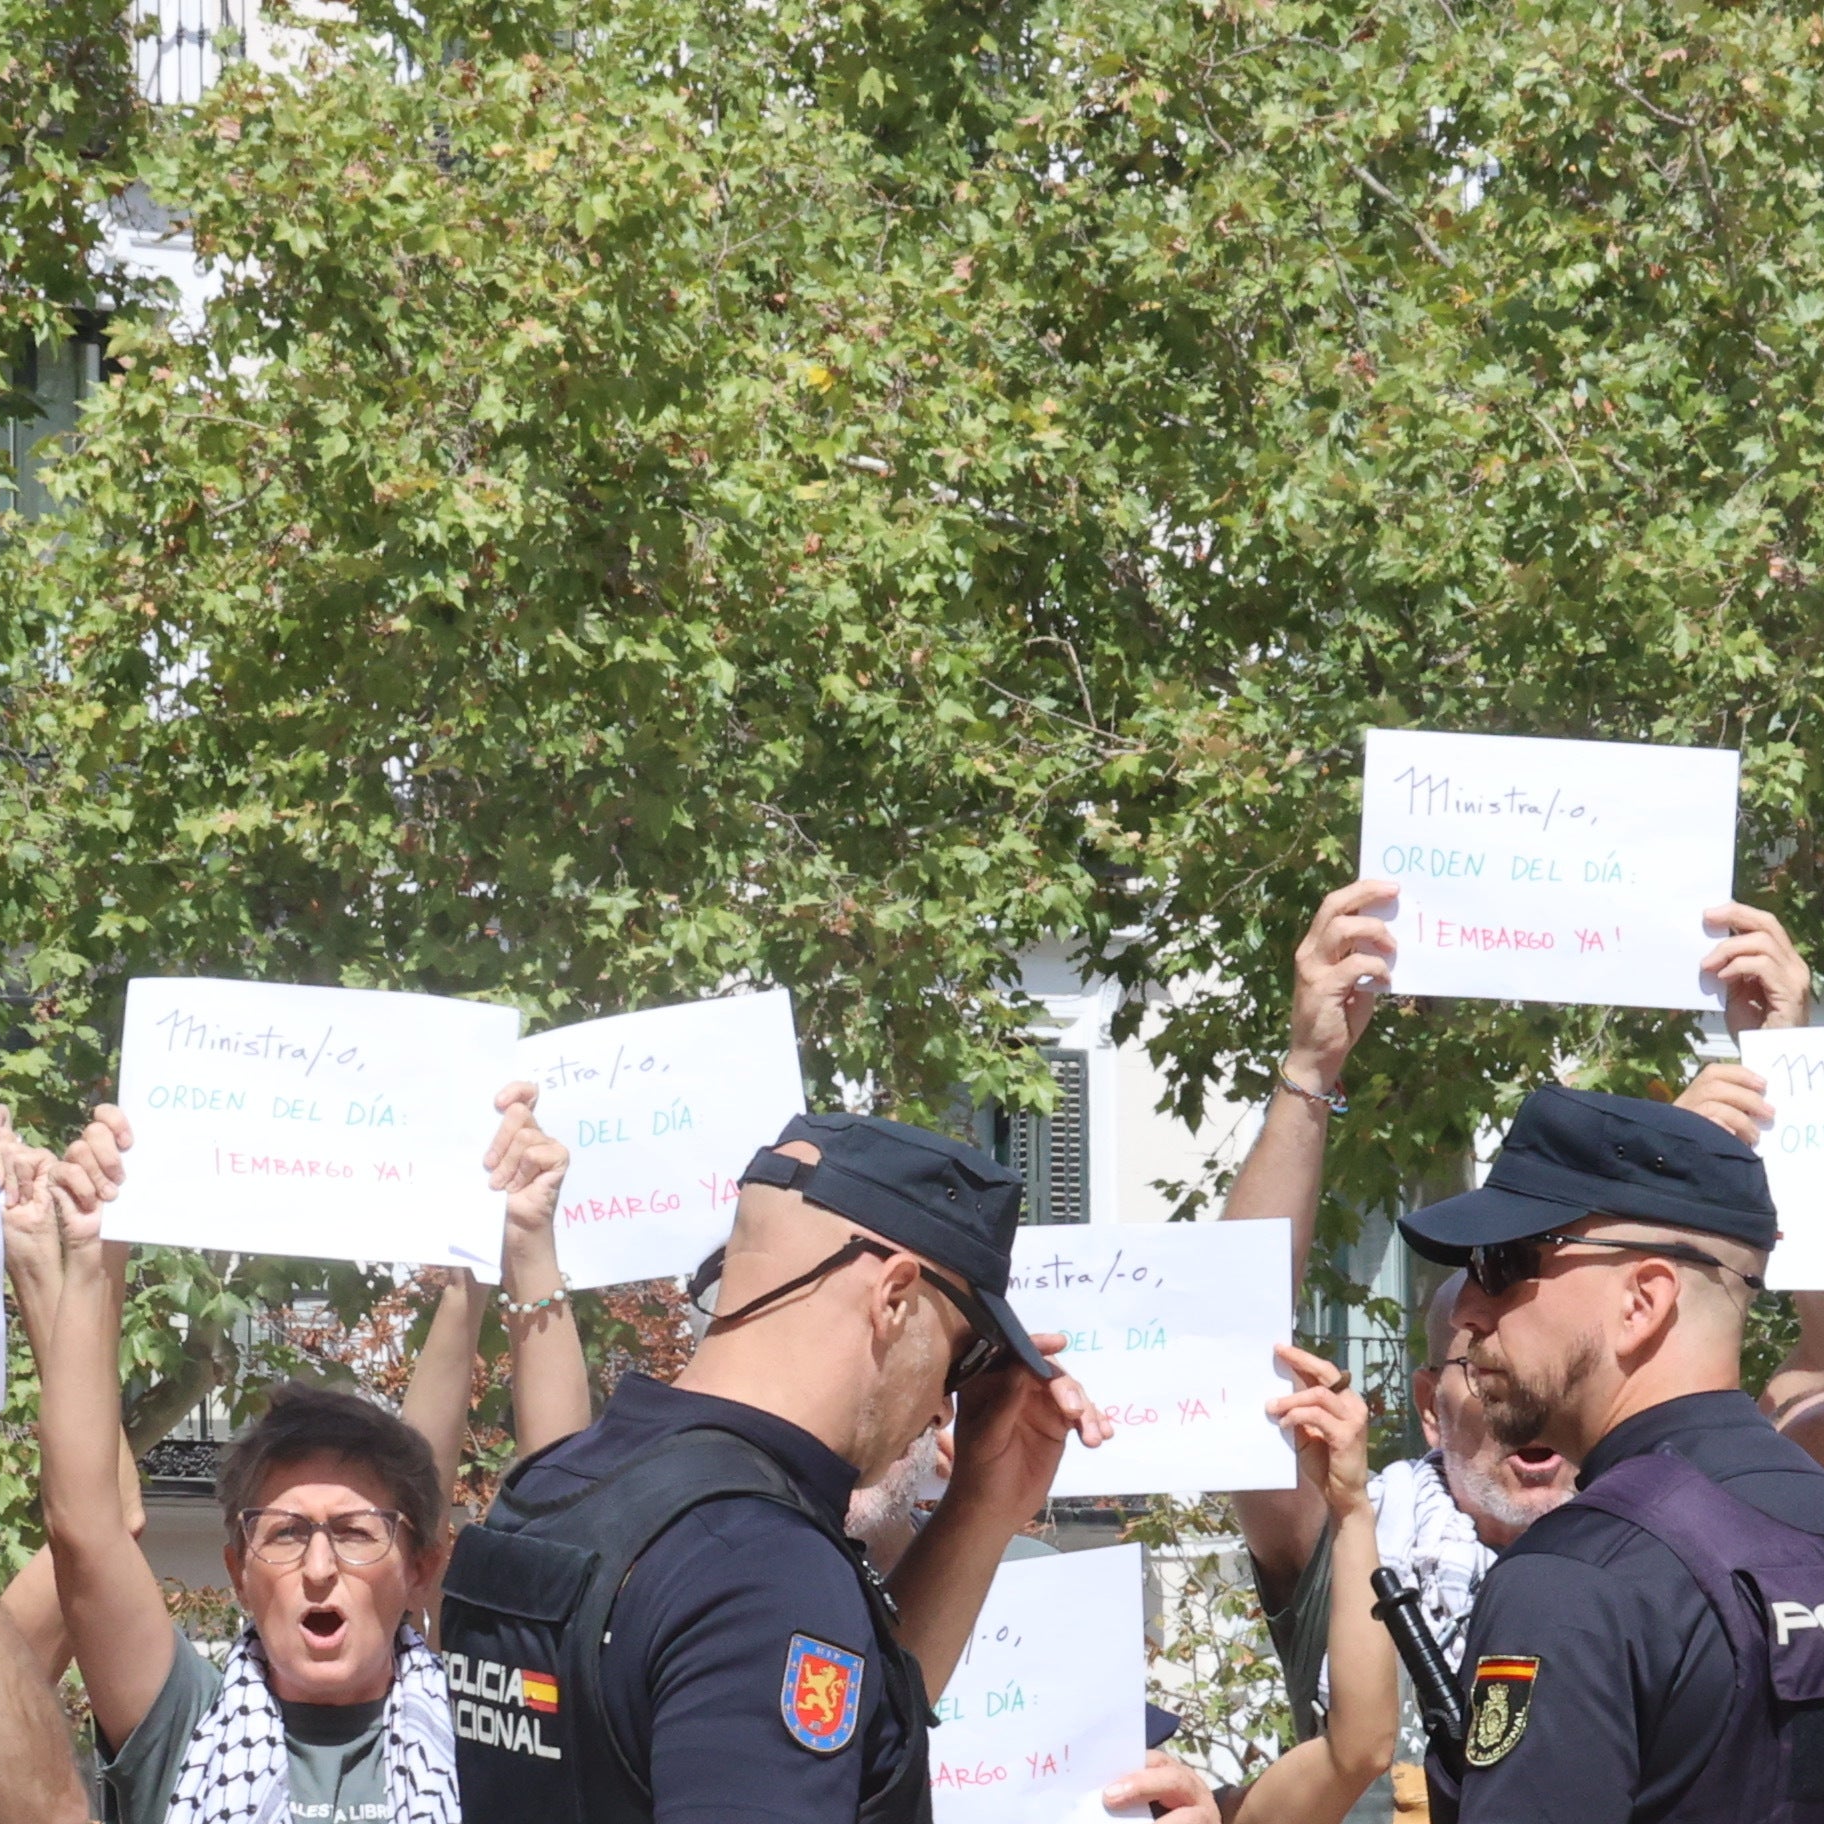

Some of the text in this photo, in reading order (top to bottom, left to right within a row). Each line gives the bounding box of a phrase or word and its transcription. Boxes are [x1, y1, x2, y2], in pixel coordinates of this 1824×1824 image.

[1382, 845, 1485, 878] ORDEN
[1511, 855, 1562, 882] DEL
[1574, 926, 1622, 954] YA!
[148, 1084, 246, 1110] ORDEN
[272, 1096, 322, 1121] DEL
[578, 1119, 631, 1147] DEL
[373, 1161, 415, 1184] YA!
[562, 1189, 681, 1229] MBARGO
[1177, 1387, 1229, 1426] YA!
[934, 1697, 964, 1723] EL
[1025, 1744, 1071, 1780] YA!
